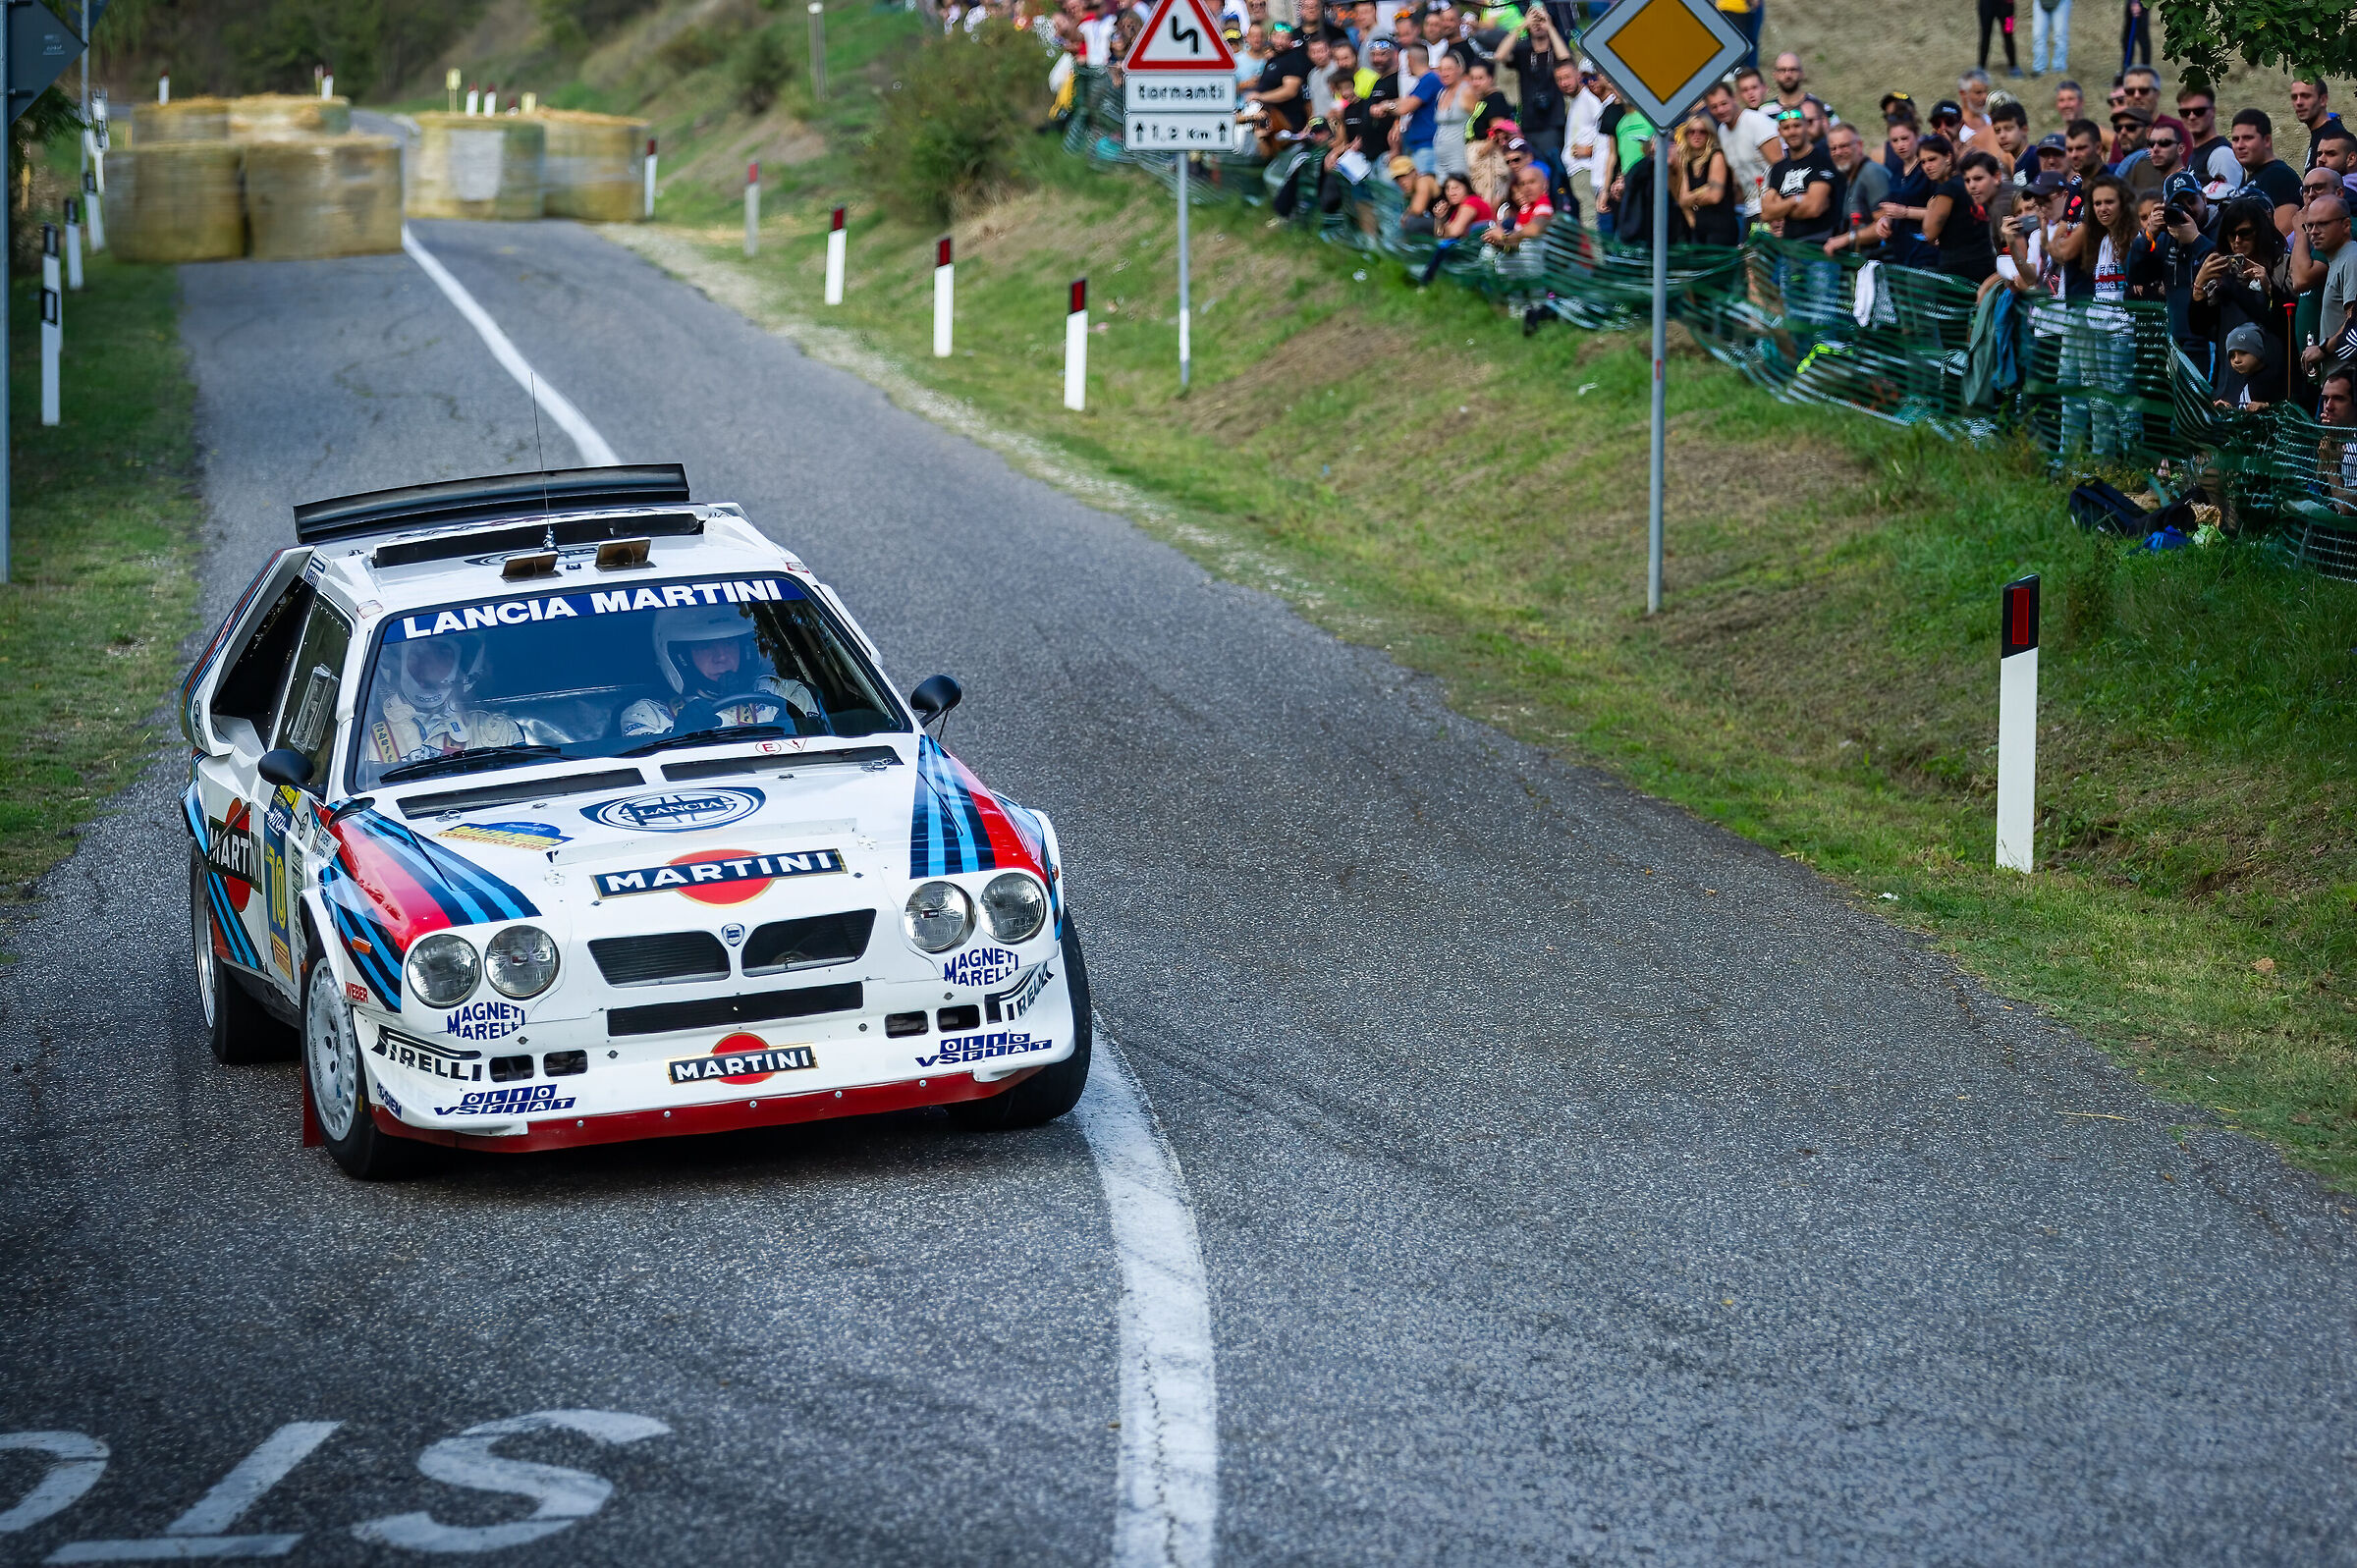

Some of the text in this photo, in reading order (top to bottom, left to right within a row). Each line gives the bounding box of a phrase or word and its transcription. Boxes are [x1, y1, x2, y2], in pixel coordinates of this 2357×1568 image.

[1138, 81, 1226, 100] tornanti
[403, 579, 783, 639] LANCIA MARTINI
[638, 800, 721, 817] LANCIA
[209, 827, 261, 884] MARTINI
[606, 852, 834, 892] MARTINI
[346, 982, 368, 1004] WEBER
[370, 1024, 483, 1082] PIRELLI
[943, 1034, 1027, 1053] OLIO
[675, 1049, 809, 1081] MARTINI
[465, 1085, 554, 1105] OLIO
